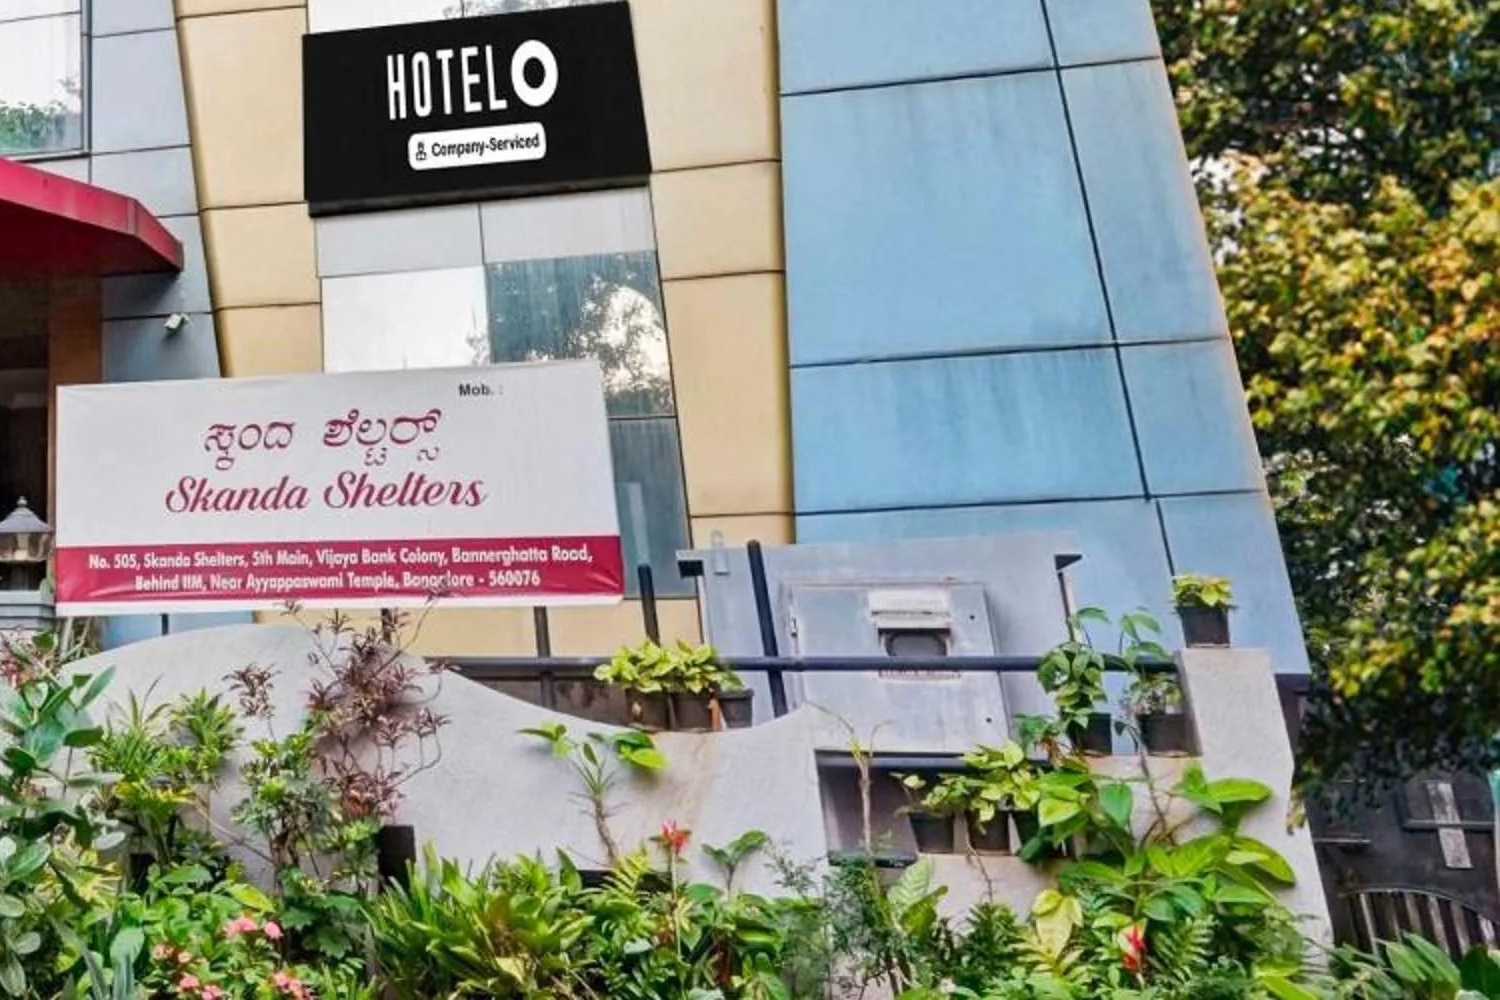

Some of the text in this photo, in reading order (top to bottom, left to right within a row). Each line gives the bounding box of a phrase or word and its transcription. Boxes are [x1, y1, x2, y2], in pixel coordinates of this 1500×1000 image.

[386, 44, 507, 120] HOTEL
[431, 132, 540, 158] Company-Serviced
[204, 420, 296, 471] ಸ್ಕಂದ
[165, 470, 489, 514] Skanda Shelters
[89, 544, 593, 571] No. 505, Skanda Shelters, 5th Main, Vijaya Bank Colony, Bannerghatta Road,
[135, 575, 179, 591] Behind
[210, 574, 242, 590] Near
[246, 573, 343, 594] Ayyappaswami
[347, 571, 399, 592] Temple,
[489, 570, 541, 588] 560076
